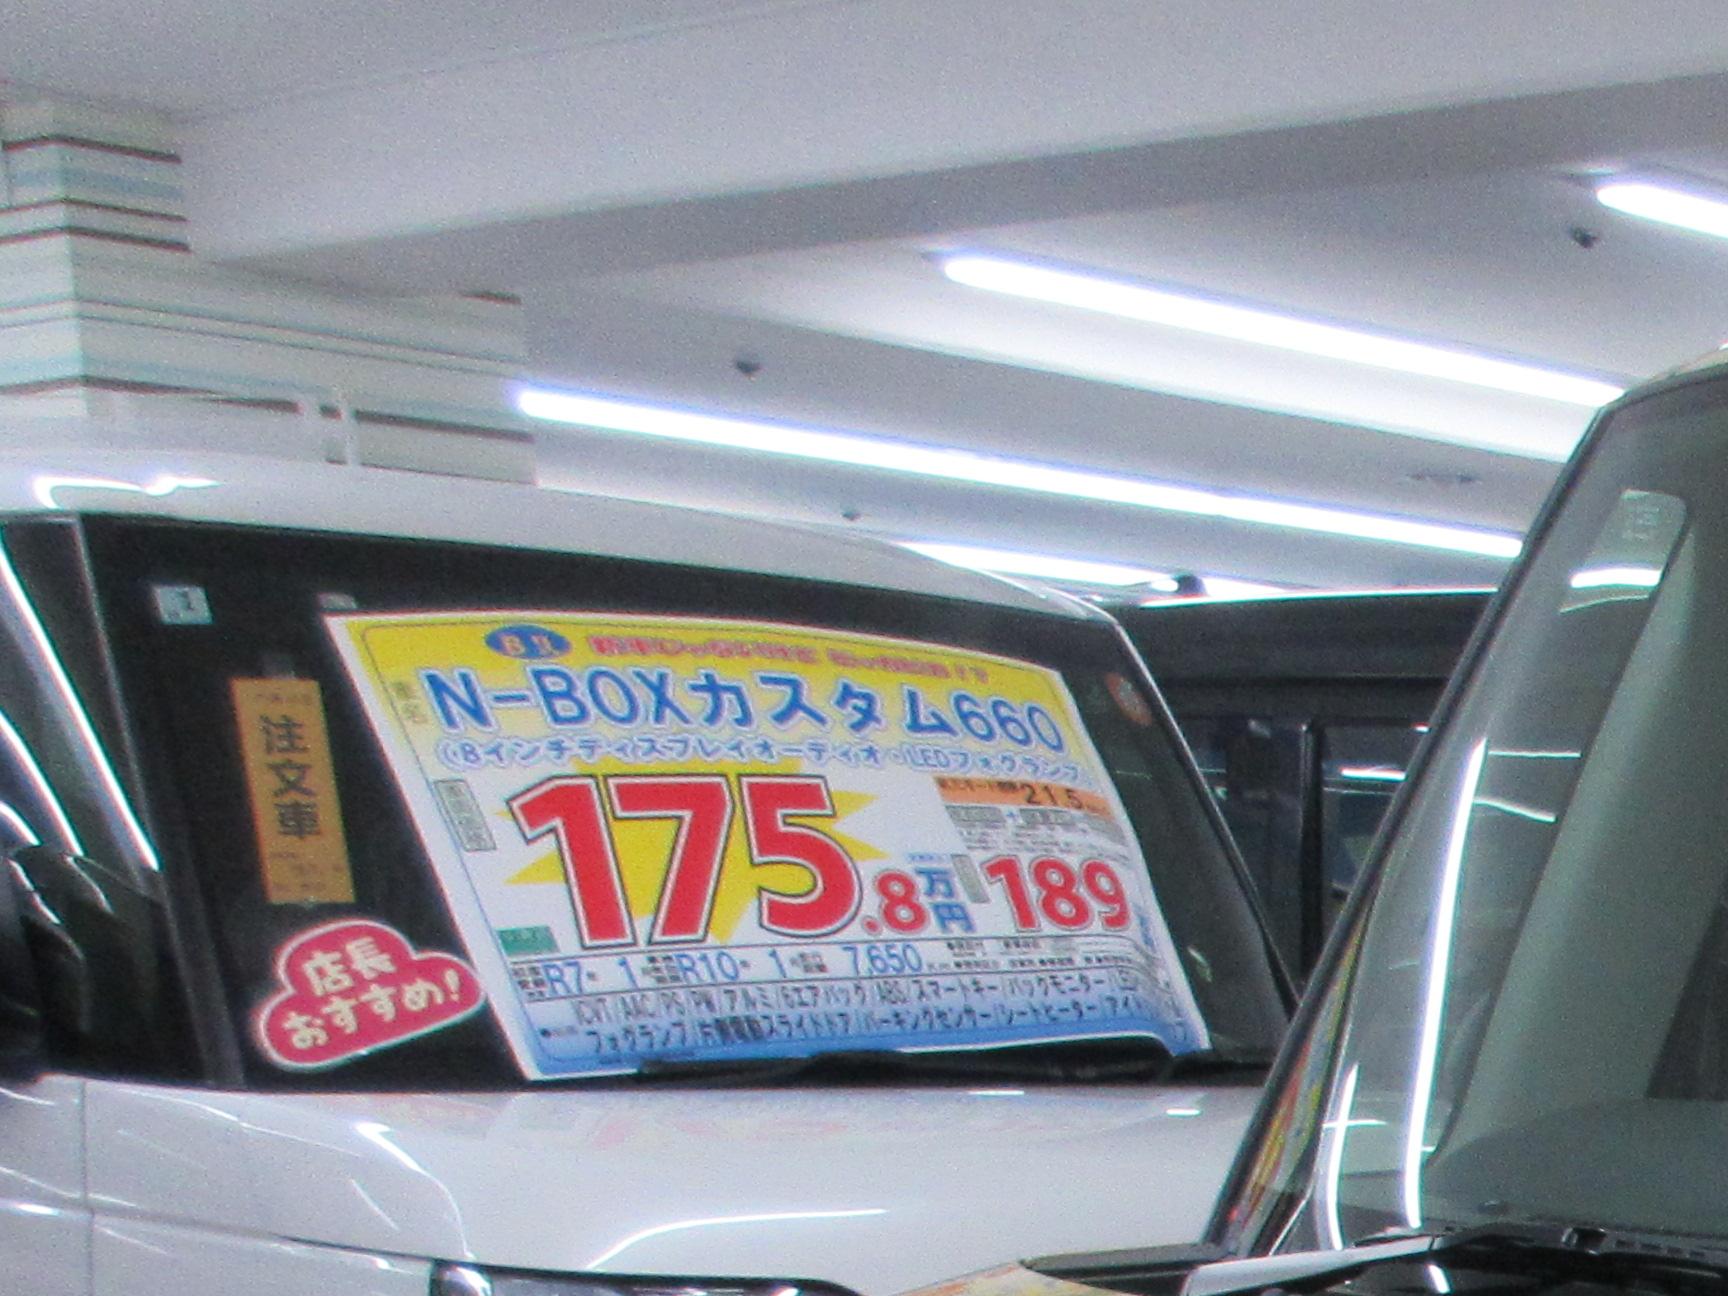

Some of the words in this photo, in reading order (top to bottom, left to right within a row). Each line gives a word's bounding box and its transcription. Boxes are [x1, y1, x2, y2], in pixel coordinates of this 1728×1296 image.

[420, 665, 1065, 753] N-BOXカスタム660
[981, 854, 1131, 933] 189
[304, 935, 397, 996] 店長
